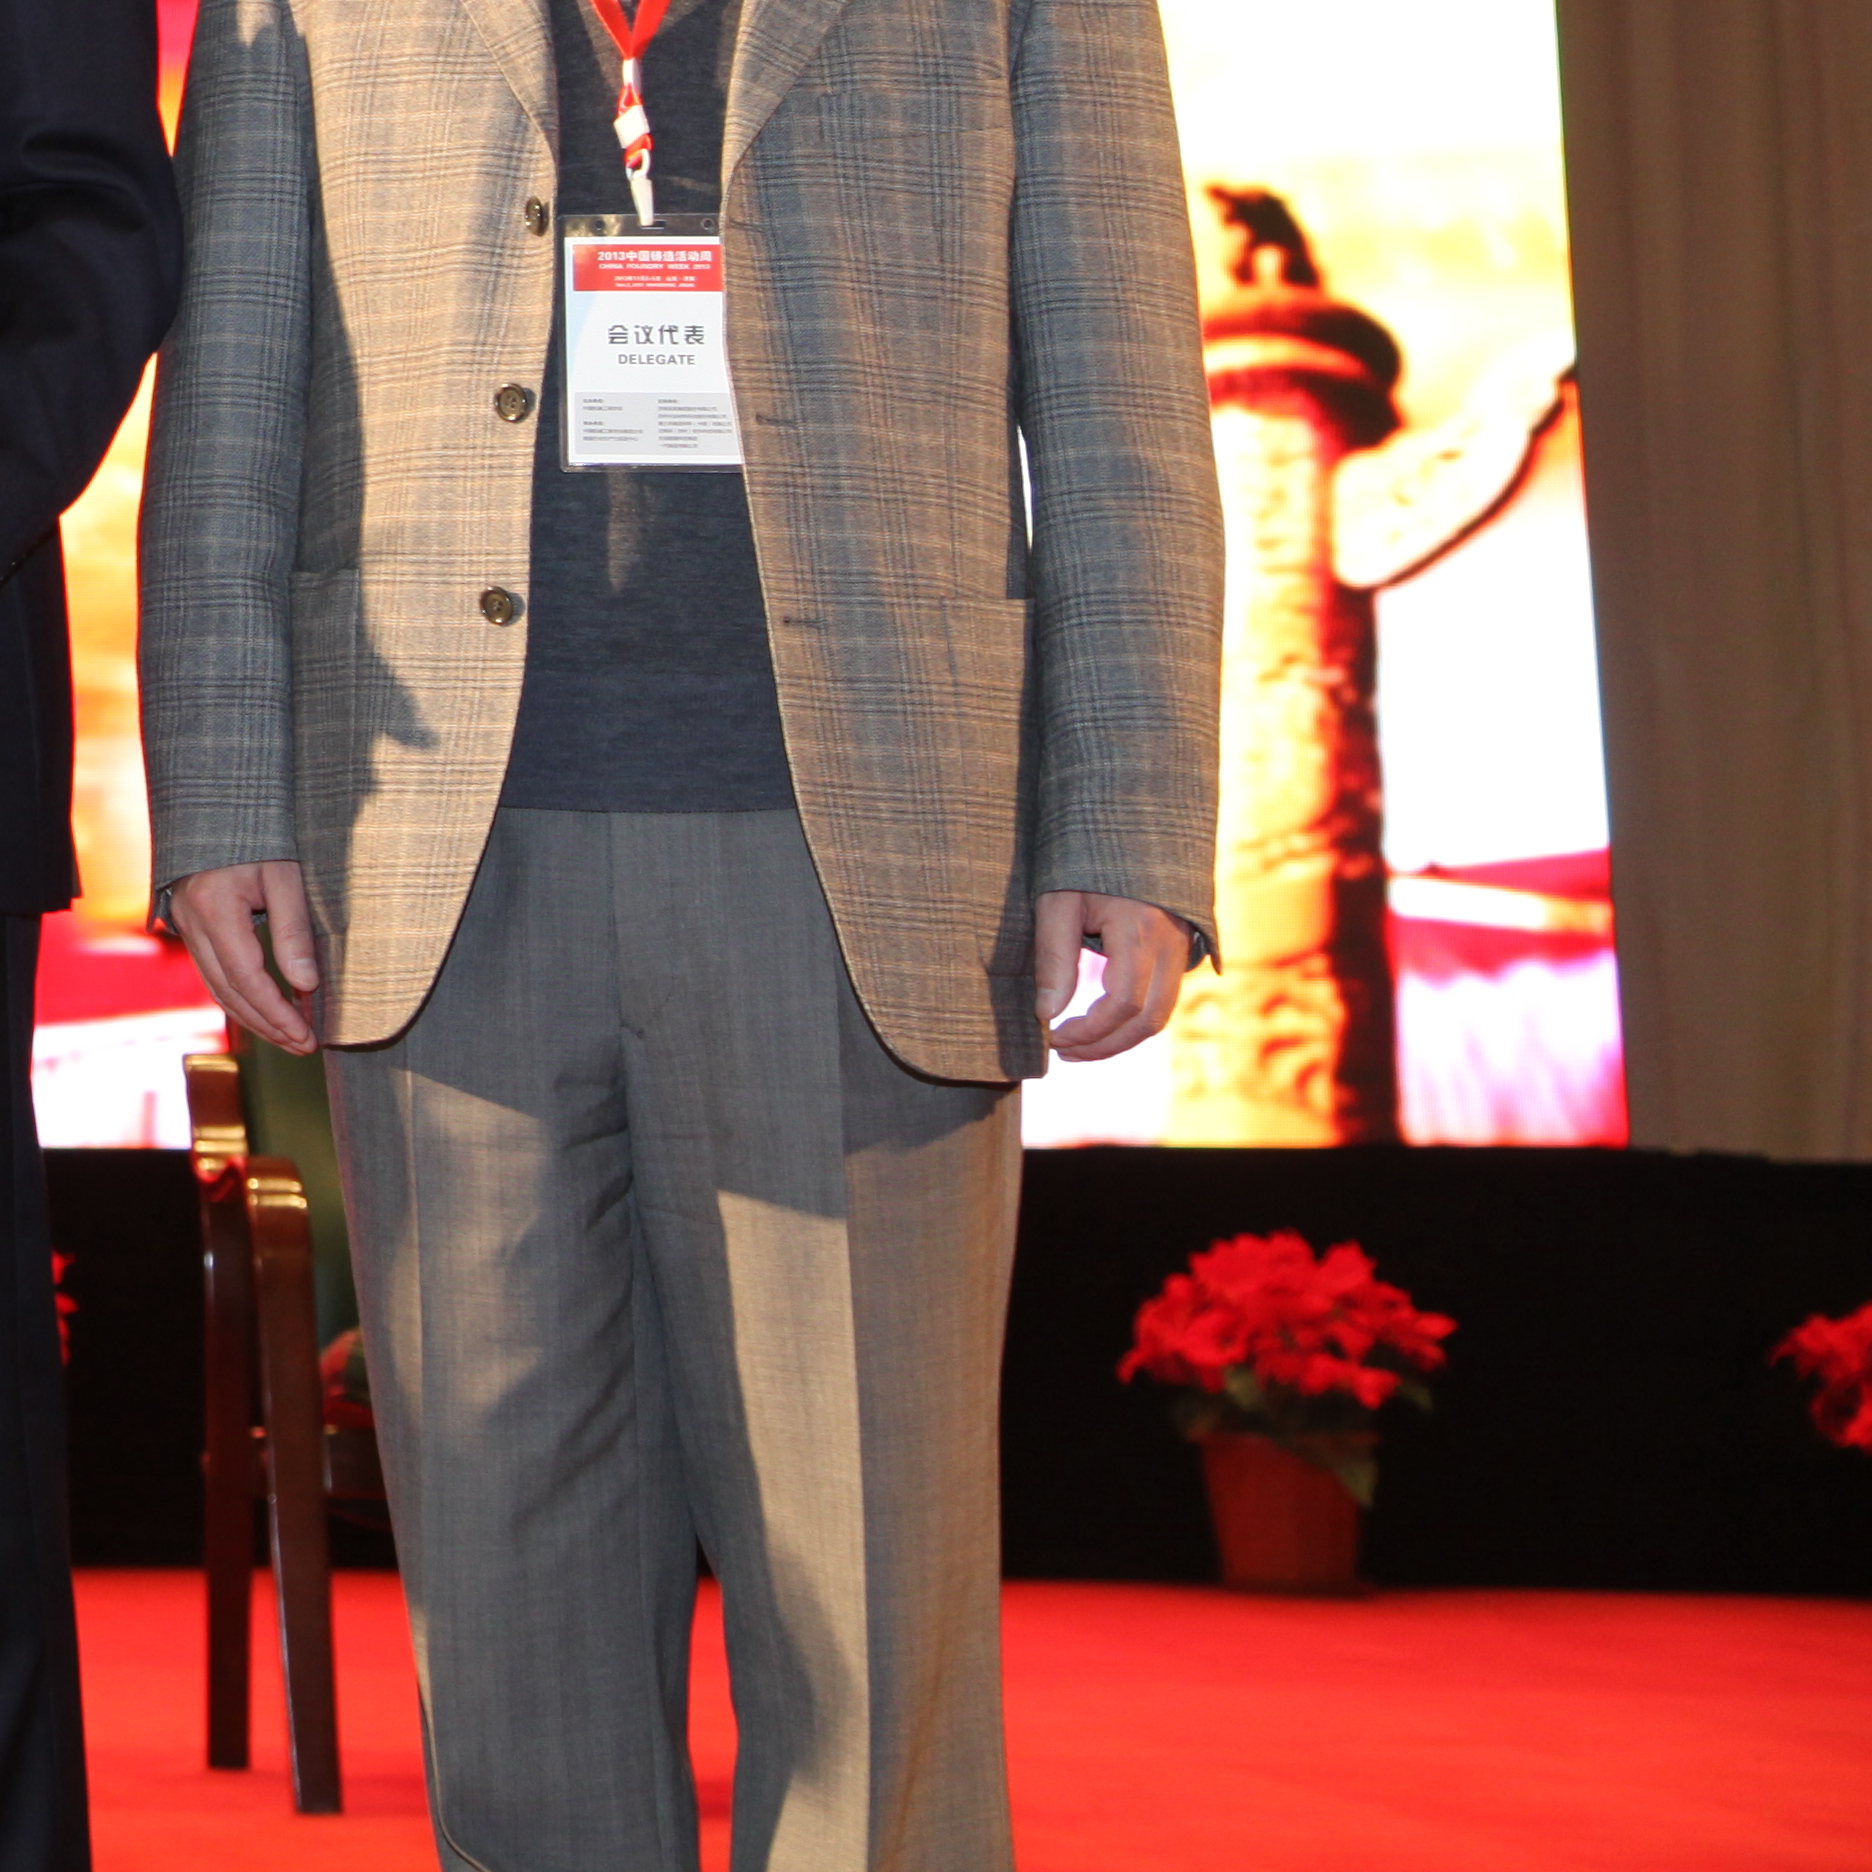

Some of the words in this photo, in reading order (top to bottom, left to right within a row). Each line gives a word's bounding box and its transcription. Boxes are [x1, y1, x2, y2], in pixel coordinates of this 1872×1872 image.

[607, 324, 706, 346] 会议代表
[617, 353, 696, 366] DELEGATE
